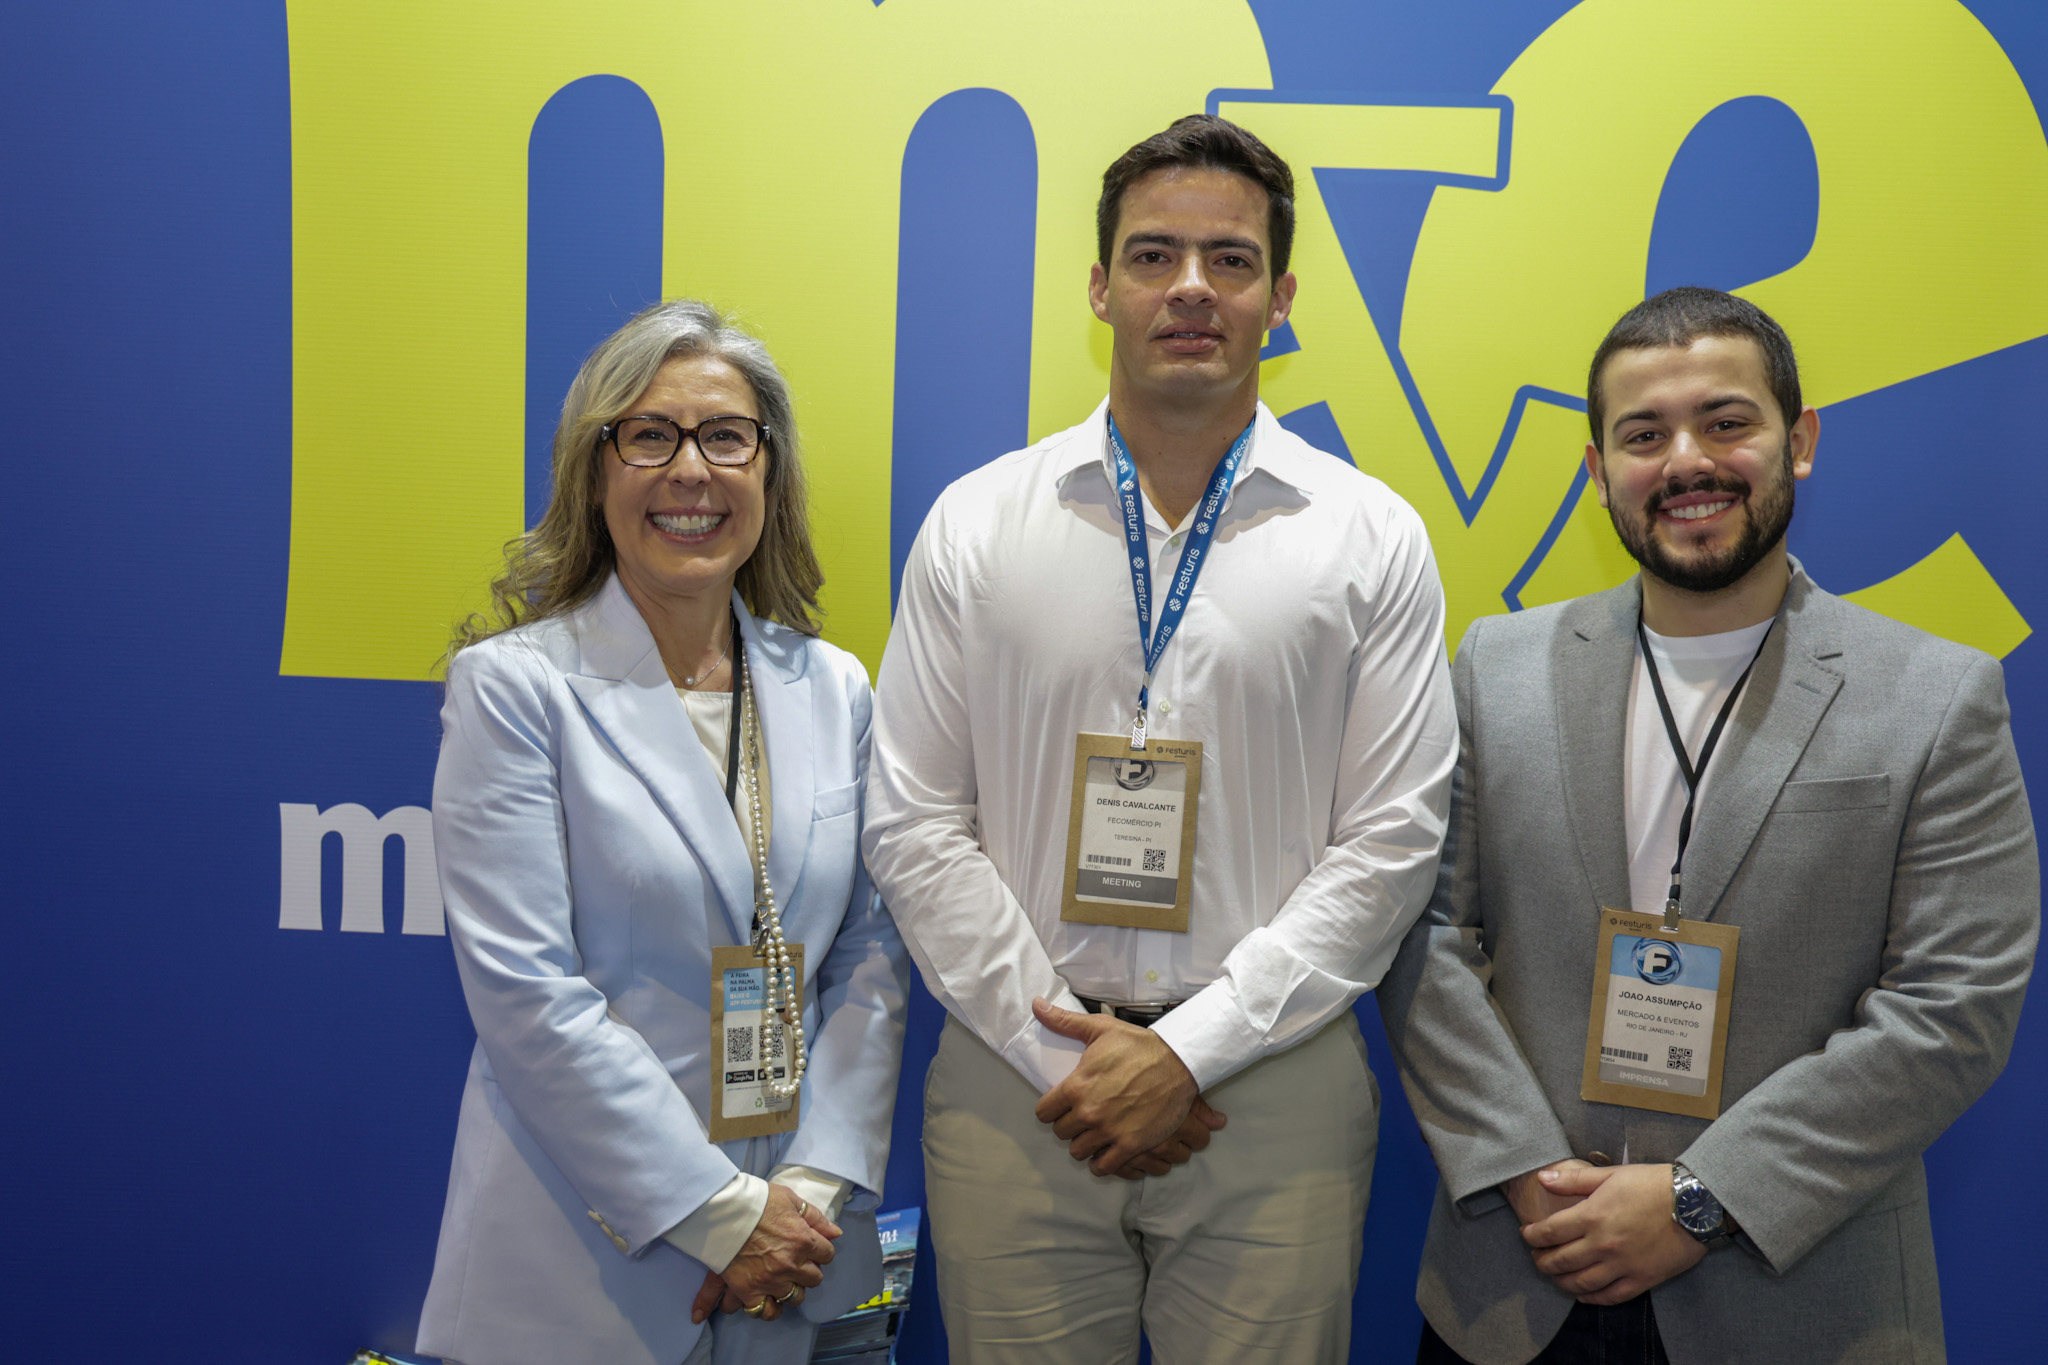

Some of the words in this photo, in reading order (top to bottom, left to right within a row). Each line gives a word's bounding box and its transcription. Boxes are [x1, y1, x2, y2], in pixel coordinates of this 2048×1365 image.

[1110, 436, 1129, 474] Festuris
[1204, 475, 1229, 520] Festuris
[1124, 494, 1139, 542] Festuris
[1175, 547, 1200, 597] Festuris
[1135, 573, 1149, 622] Festuris
[1165, 747, 1196, 756] Festuris
[1096, 798, 1121, 808] DENIS
[1122, 800, 1176, 812] CAVALCANTE
[1107, 816, 1152, 828] FECOMÉRCIO
[1152, 821, 1162, 829] PI
[1114, 834, 1142, 843] TERESINA
[1102, 876, 1142, 889] MEETING
[1619, 920, 1652, 930] Festuris
[1618, 990, 1644, 1001] JOAO
[1645, 995, 1703, 1011] ASSUMPÇÃO
[1617, 1009, 1655, 1021] MERCADO
[1663, 1016, 1700, 1029] EVENTOS
[1626, 1022, 1637, 1030] RIO
[1638, 1024, 1647, 1032] DE
[1648, 1026, 1675, 1036] JANEIRO
[1619, 1071, 1669, 1087] IMPRENSA
